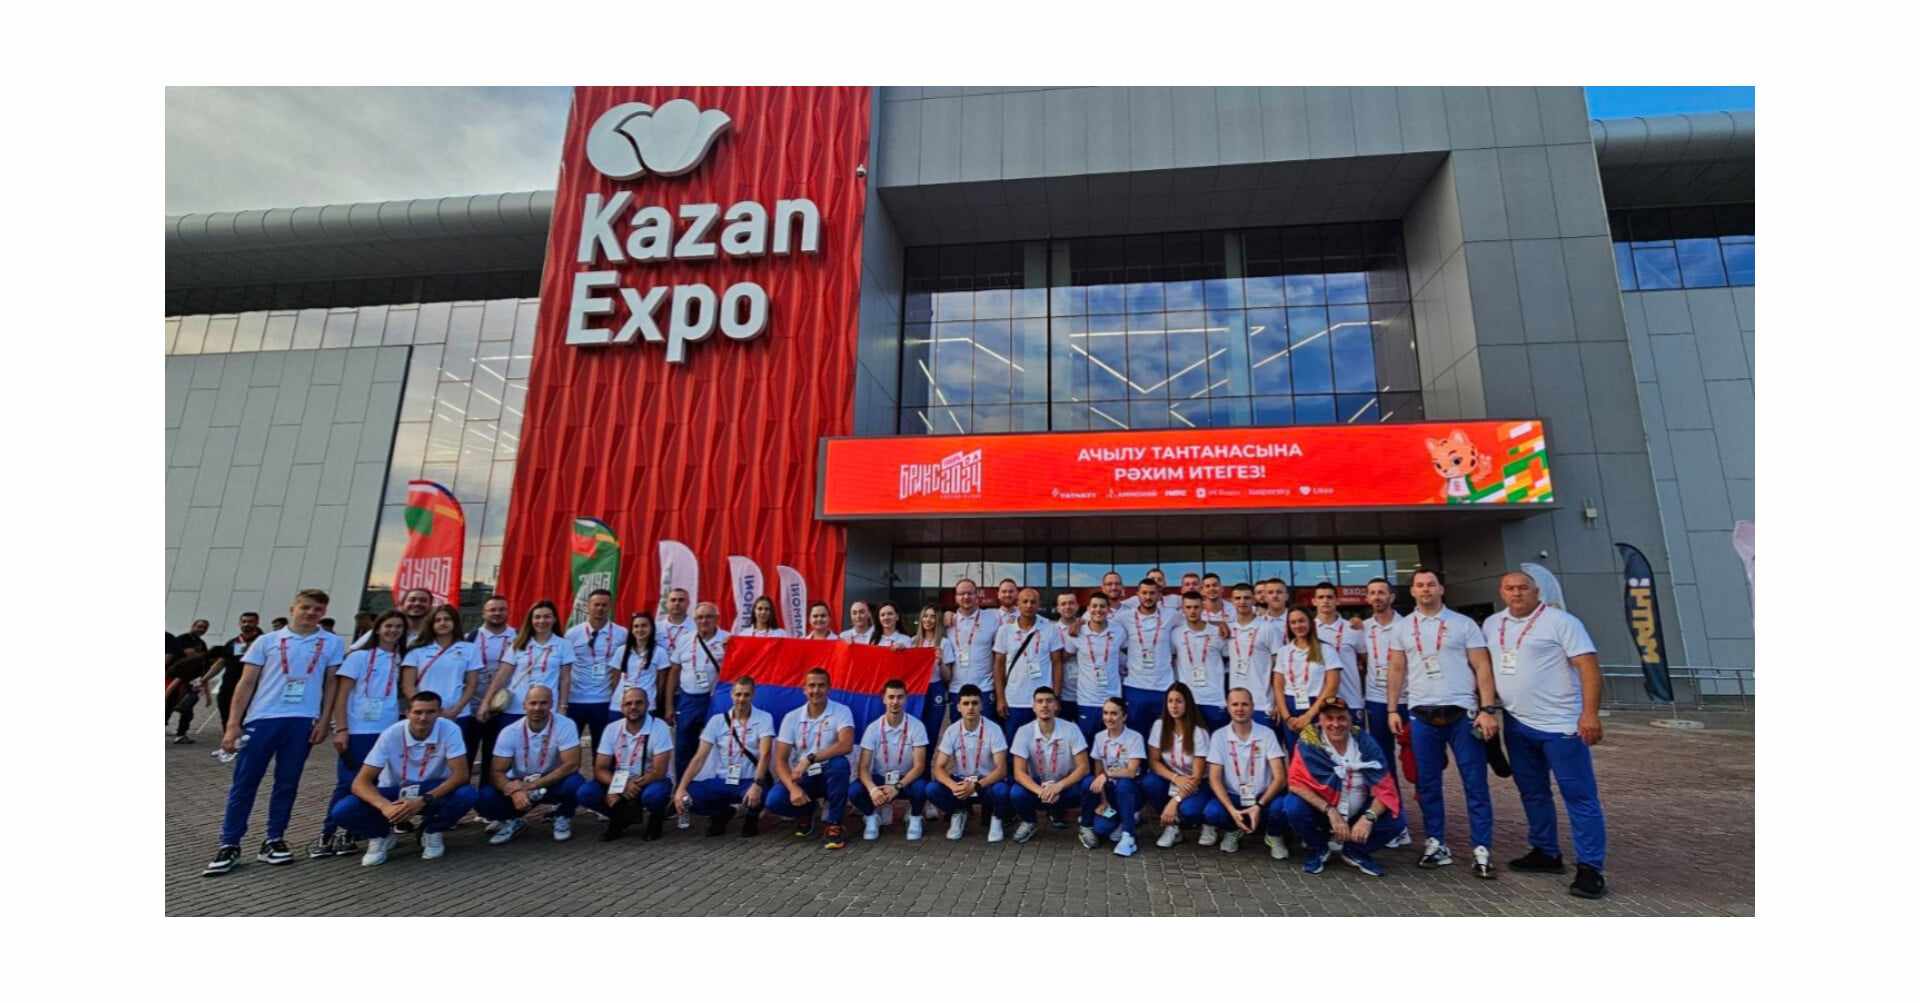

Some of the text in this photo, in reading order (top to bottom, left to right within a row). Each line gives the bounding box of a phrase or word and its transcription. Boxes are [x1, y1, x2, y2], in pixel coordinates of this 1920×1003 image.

[576, 190, 820, 265] Kazan
[565, 270, 769, 364] Expo
[1078, 443, 1304, 462] АЧЫЛУ ТАНТАНАСЫНА
[1114, 465, 1267, 481] РӘХИМ ИТЕГЕЗ!
